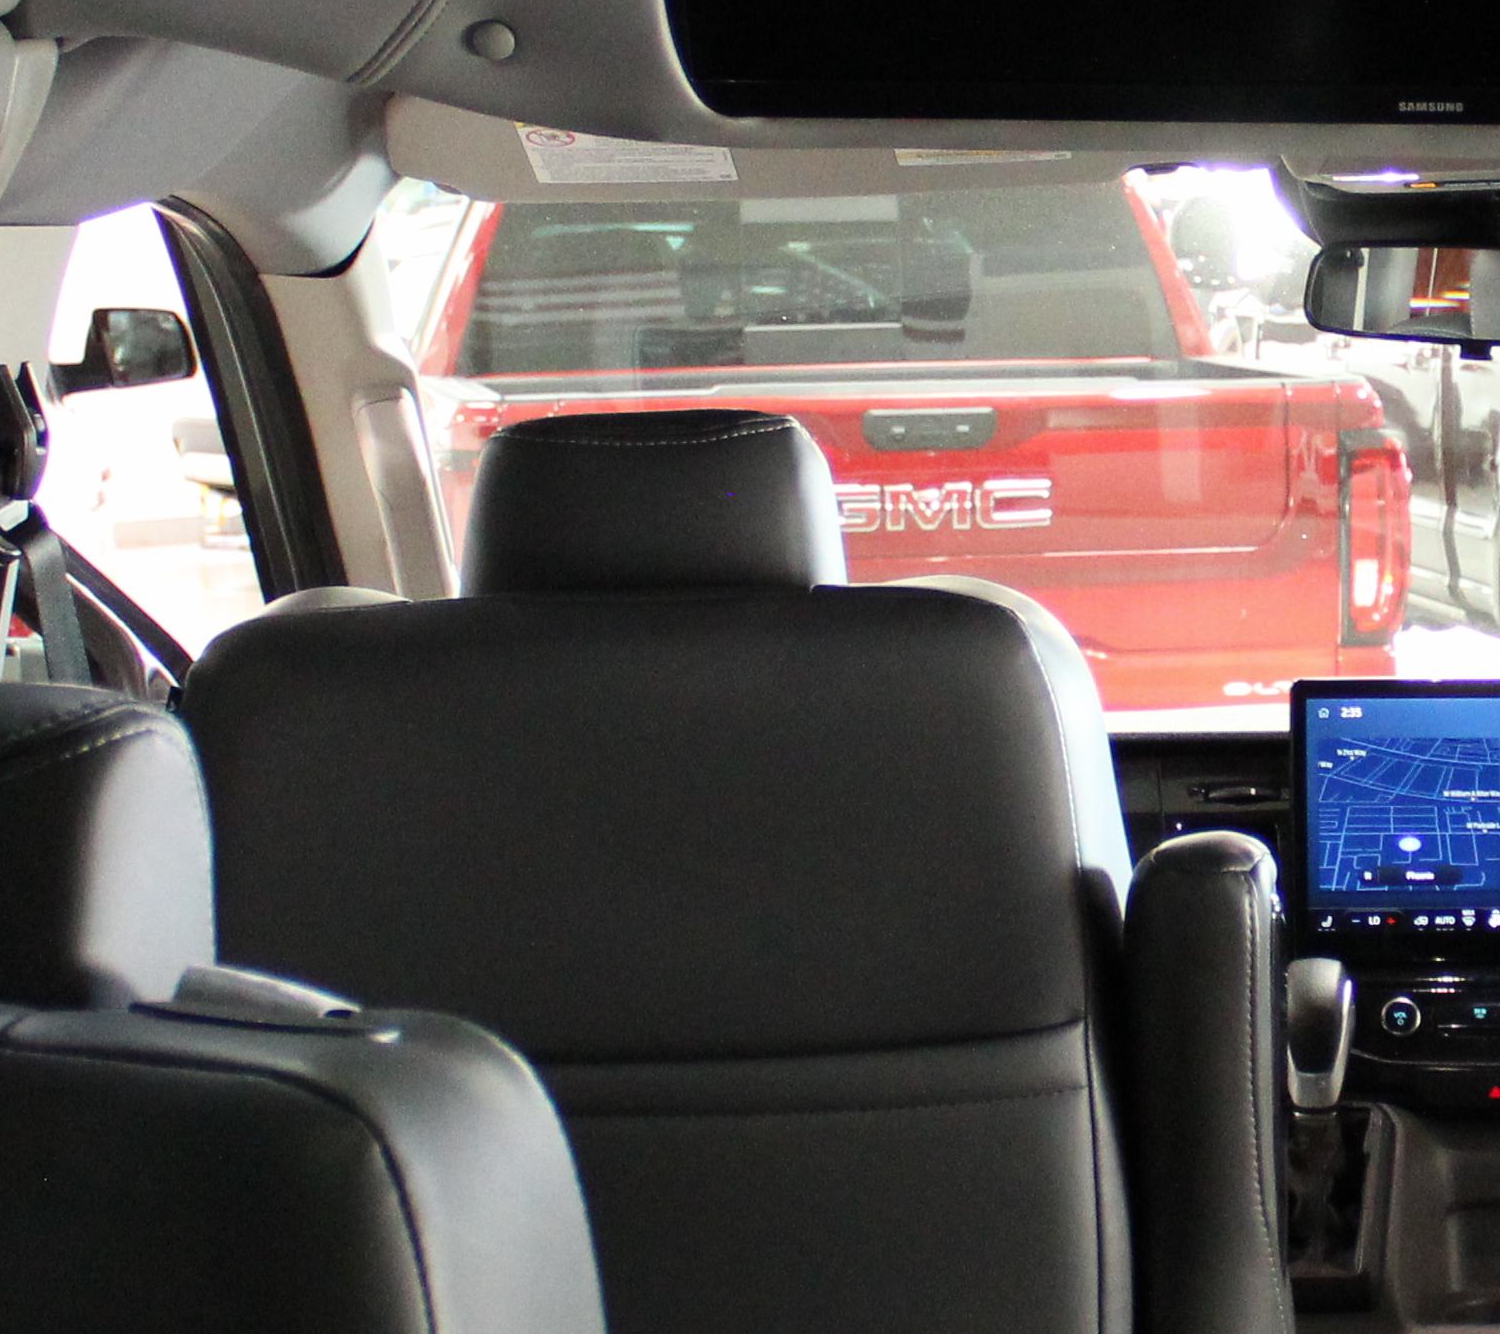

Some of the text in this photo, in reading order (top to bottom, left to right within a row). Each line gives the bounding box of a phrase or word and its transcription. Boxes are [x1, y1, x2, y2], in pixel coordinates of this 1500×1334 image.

[1398, 101, 1464, 112] SAMSUNG
[832, 478, 1053, 533] GMC
[1340, 706, 1363, 718] 2:35
[1434, 915, 1457, 926] AUTO
